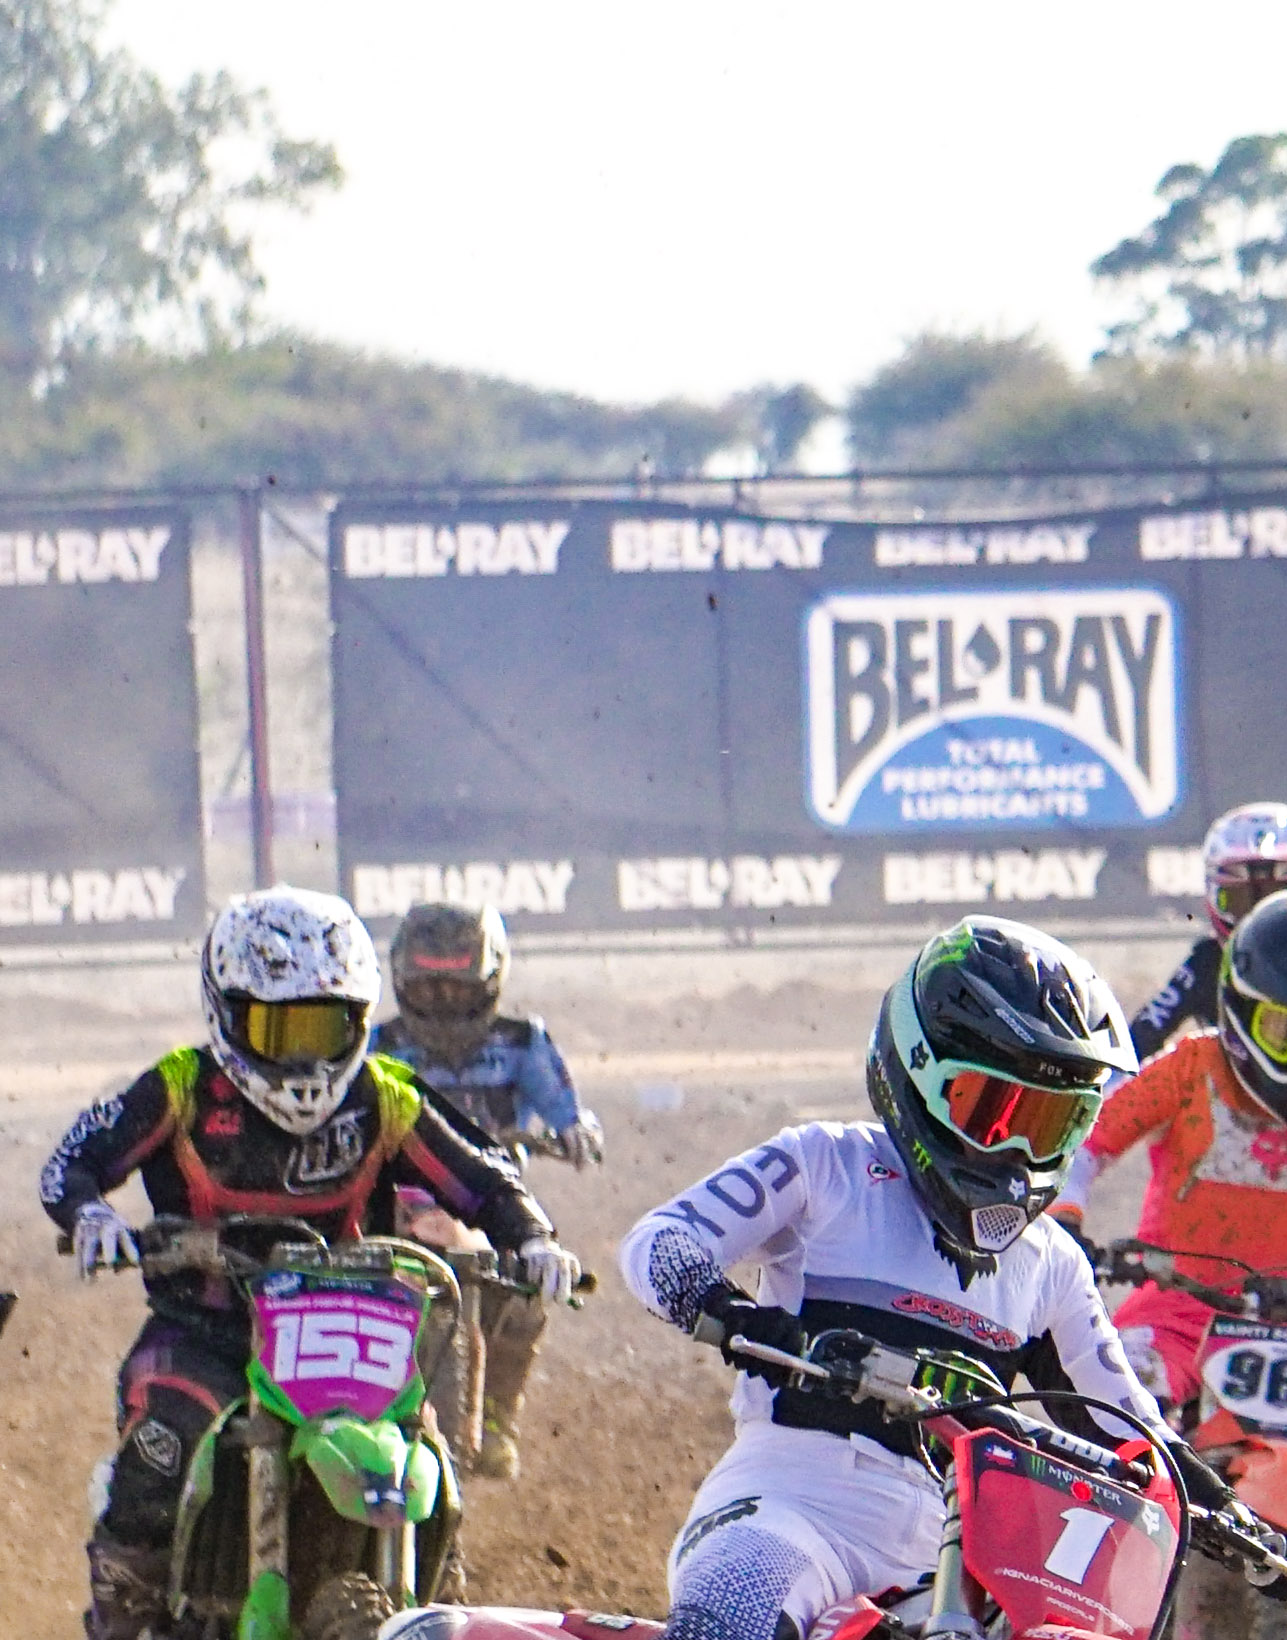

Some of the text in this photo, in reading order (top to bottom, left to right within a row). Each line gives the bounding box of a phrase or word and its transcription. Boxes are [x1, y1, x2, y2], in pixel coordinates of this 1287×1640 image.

[947, 738, 1040, 765] TOTAL
[901, 791, 1088, 821] LUBRICANTS
[1039, 1061, 1063, 1078] FOX
[272, 1311, 412, 1392] 153
[1044, 1507, 1115, 1586] 1
